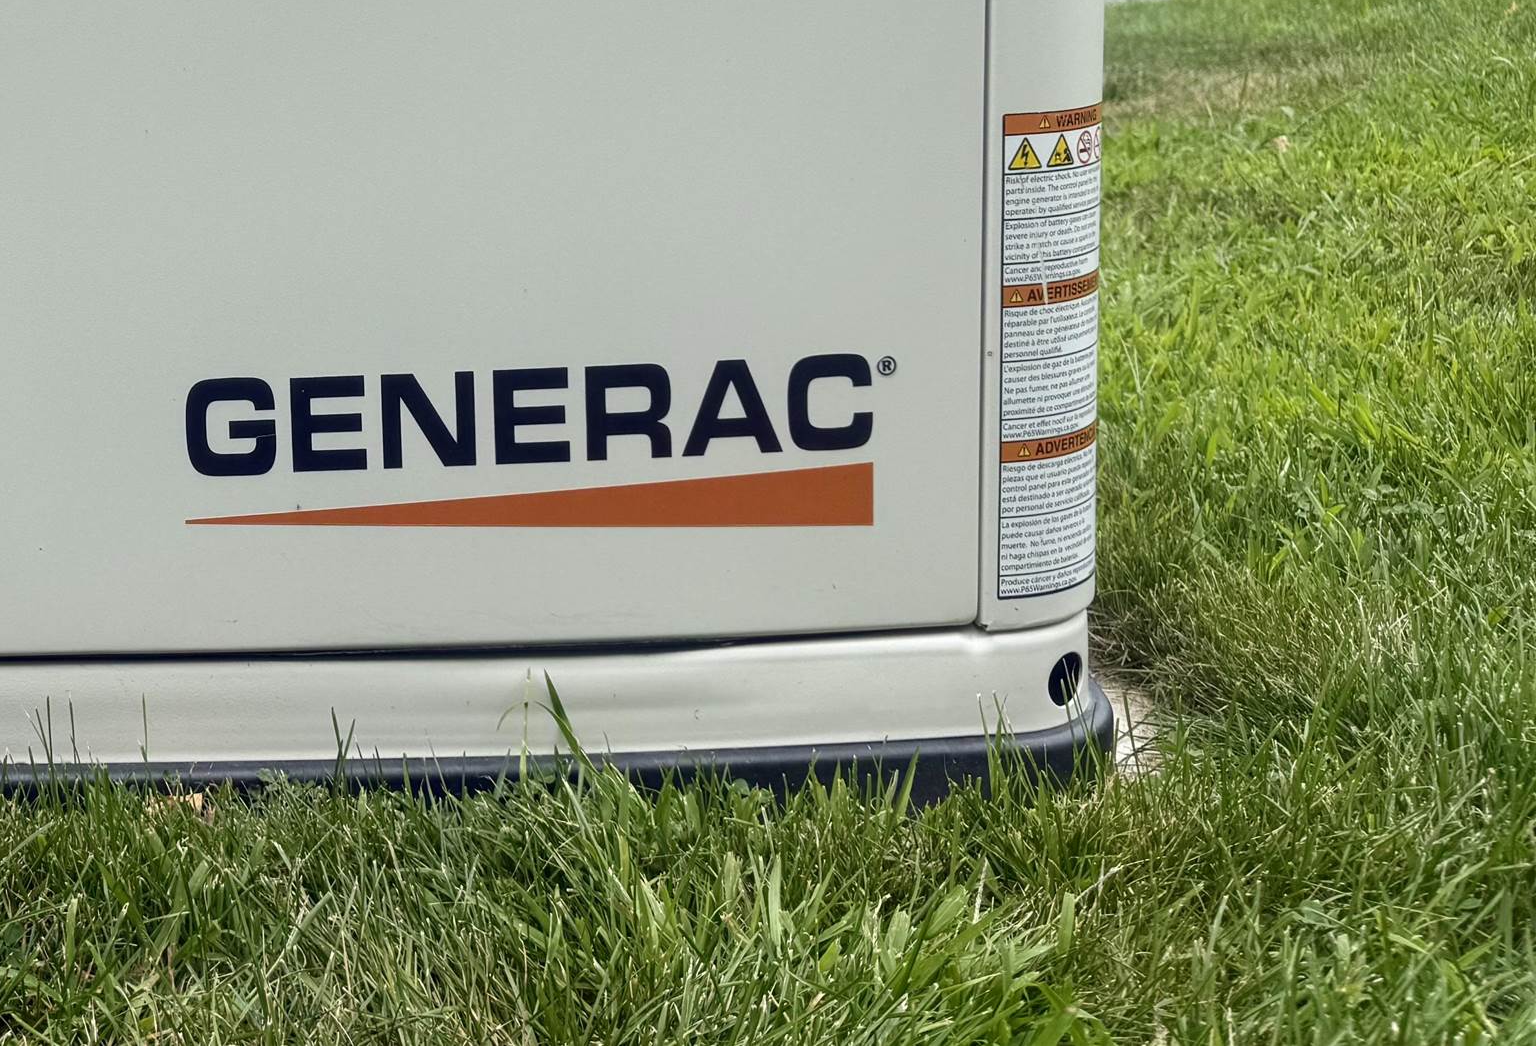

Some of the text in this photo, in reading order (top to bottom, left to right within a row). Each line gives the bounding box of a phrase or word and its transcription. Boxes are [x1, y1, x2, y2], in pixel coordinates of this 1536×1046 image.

[1056, 109, 1096, 127] WARNING
[1030, 175, 1053, 183] electric
[1060, 181, 1077, 190] control
[1006, 197, 1030, 206] engine
[1032, 194, 1062, 205] generator
[1048, 203, 1072, 212] qualified
[1005, 222, 1038, 230] Explosion
[1049, 217, 1069, 226] battery
[1060, 237, 1074, 245] cause
[1005, 252, 1030, 261] vicinity
[1032, 251, 1038, 259] of
[1053, 248, 1072, 257] battery
[1005, 268, 1080, 283] www.P65Wrnings.ca.gov
[1004, 309, 1028, 318] Risque
[1039, 306, 1054, 314] choc
[1004, 319, 1037, 328] réparable
[1004, 340, 1030, 348] destiné
[1037, 337, 1049, 345] être
[1004, 349, 1039, 359] personnel
[1004, 364, 1041, 374] L'explosion
[1052, 361, 1062, 369] gaz
[1004, 376, 1027, 384] causer
[1041, 370, 1067, 380] blessures
[1059, 381, 1068, 389] pas
[1004, 397, 1035, 405] allumette
[1044, 391, 1071, 403] provoquer
[185, 353, 874, 477] GENERAC
[1004, 408, 1035, 417] proximité
[1037, 406, 1044, 414] de
[1003, 422, 1027, 431] Cancer
[1037, 419, 1051, 428] effet
[1052, 416, 1065, 425] nocif
[1003, 465, 1025, 473] Riesgo
[1027, 463, 1035, 471] de
[1037, 459, 1063, 470] descarga
[1002, 475, 1024, 483] piezas
[1025, 474, 1038, 482] que
[1047, 469, 1066, 478] usuario
[1002, 484, 1027, 493] control
[1029, 482, 1046, 492] panel
[1048, 481, 1060, 489] para
[1002, 494, 1016, 503] está
[1018, 491, 1050, 501] destinado
[1016, 503, 1044, 513] personal
[1046, 500, 1053, 508] de
[1055, 497, 1073, 507] servicio
[1011, 520, 1041, 529] explosión
[1002, 532, 1023, 540] puede
[1025, 530, 1044, 538] causar
[1001, 542, 1027, 550] muerte.
[1009, 552, 1025, 561] haga
[1001, 560, 1052, 571] compartimiento
[1001, 578, 1030, 586] Produce
[1031, 575, 1051, 584] cáncer
